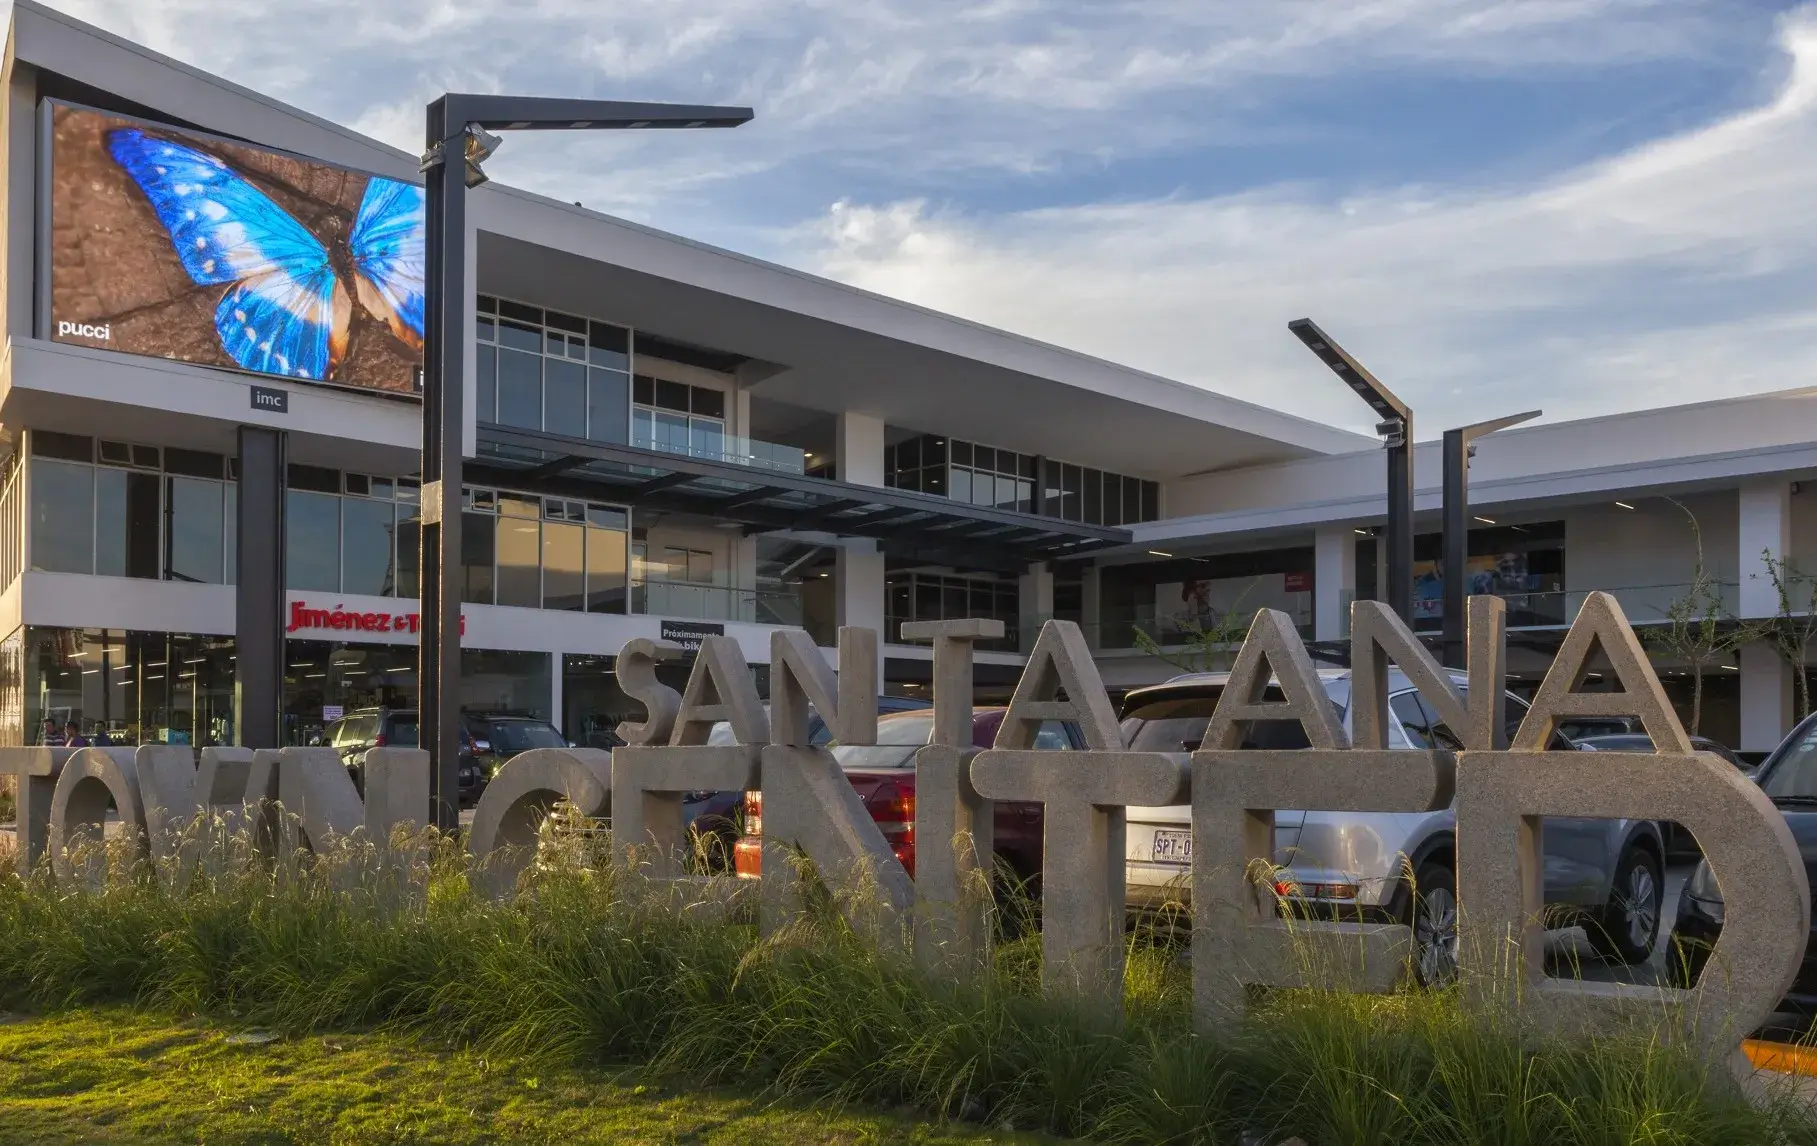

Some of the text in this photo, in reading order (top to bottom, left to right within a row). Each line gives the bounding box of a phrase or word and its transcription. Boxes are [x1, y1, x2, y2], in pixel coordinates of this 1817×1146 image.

[59, 321, 110, 340] pucci
[256, 391, 282, 407] imc
[286, 601, 391, 632] Jiménez
[614, 591, 1693, 752] SANTA ANA
